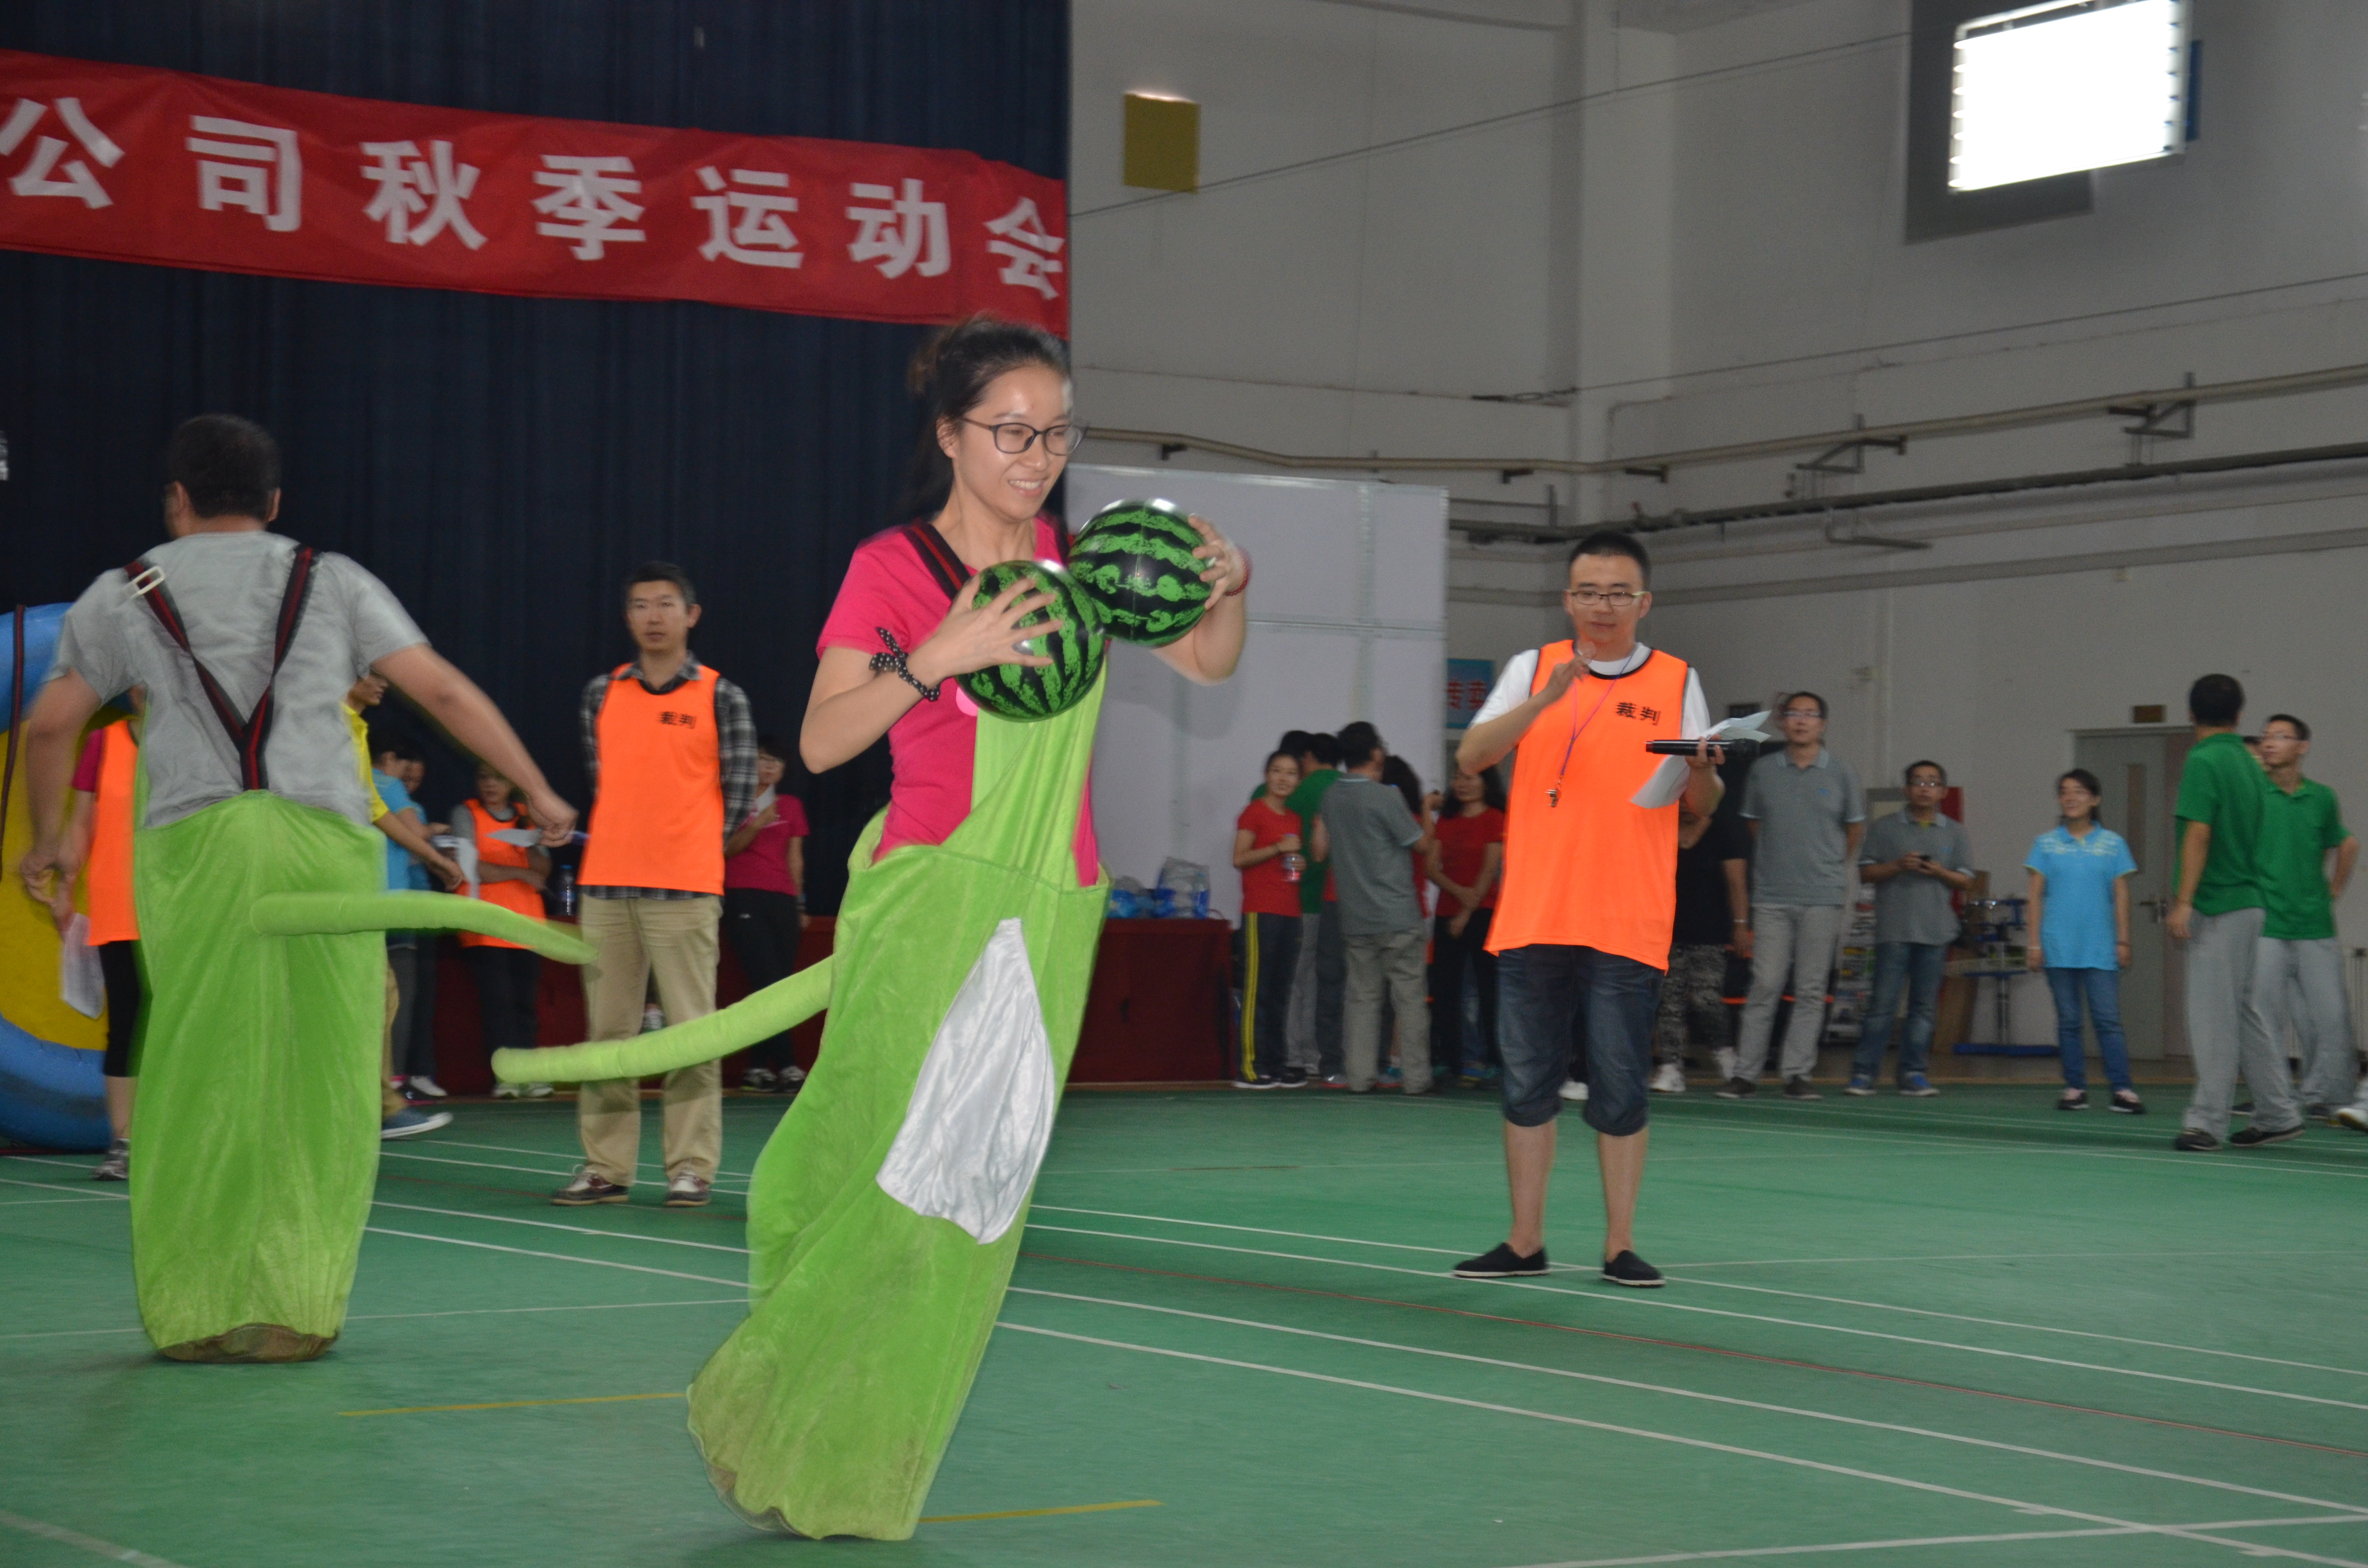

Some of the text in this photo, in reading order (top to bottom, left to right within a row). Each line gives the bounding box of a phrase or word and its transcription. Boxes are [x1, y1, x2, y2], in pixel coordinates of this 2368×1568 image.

[0, 97, 1064, 301] 公司秋季运动会
[659, 711, 697, 729] 裁判
[1616, 702, 1661, 726] 裁判
